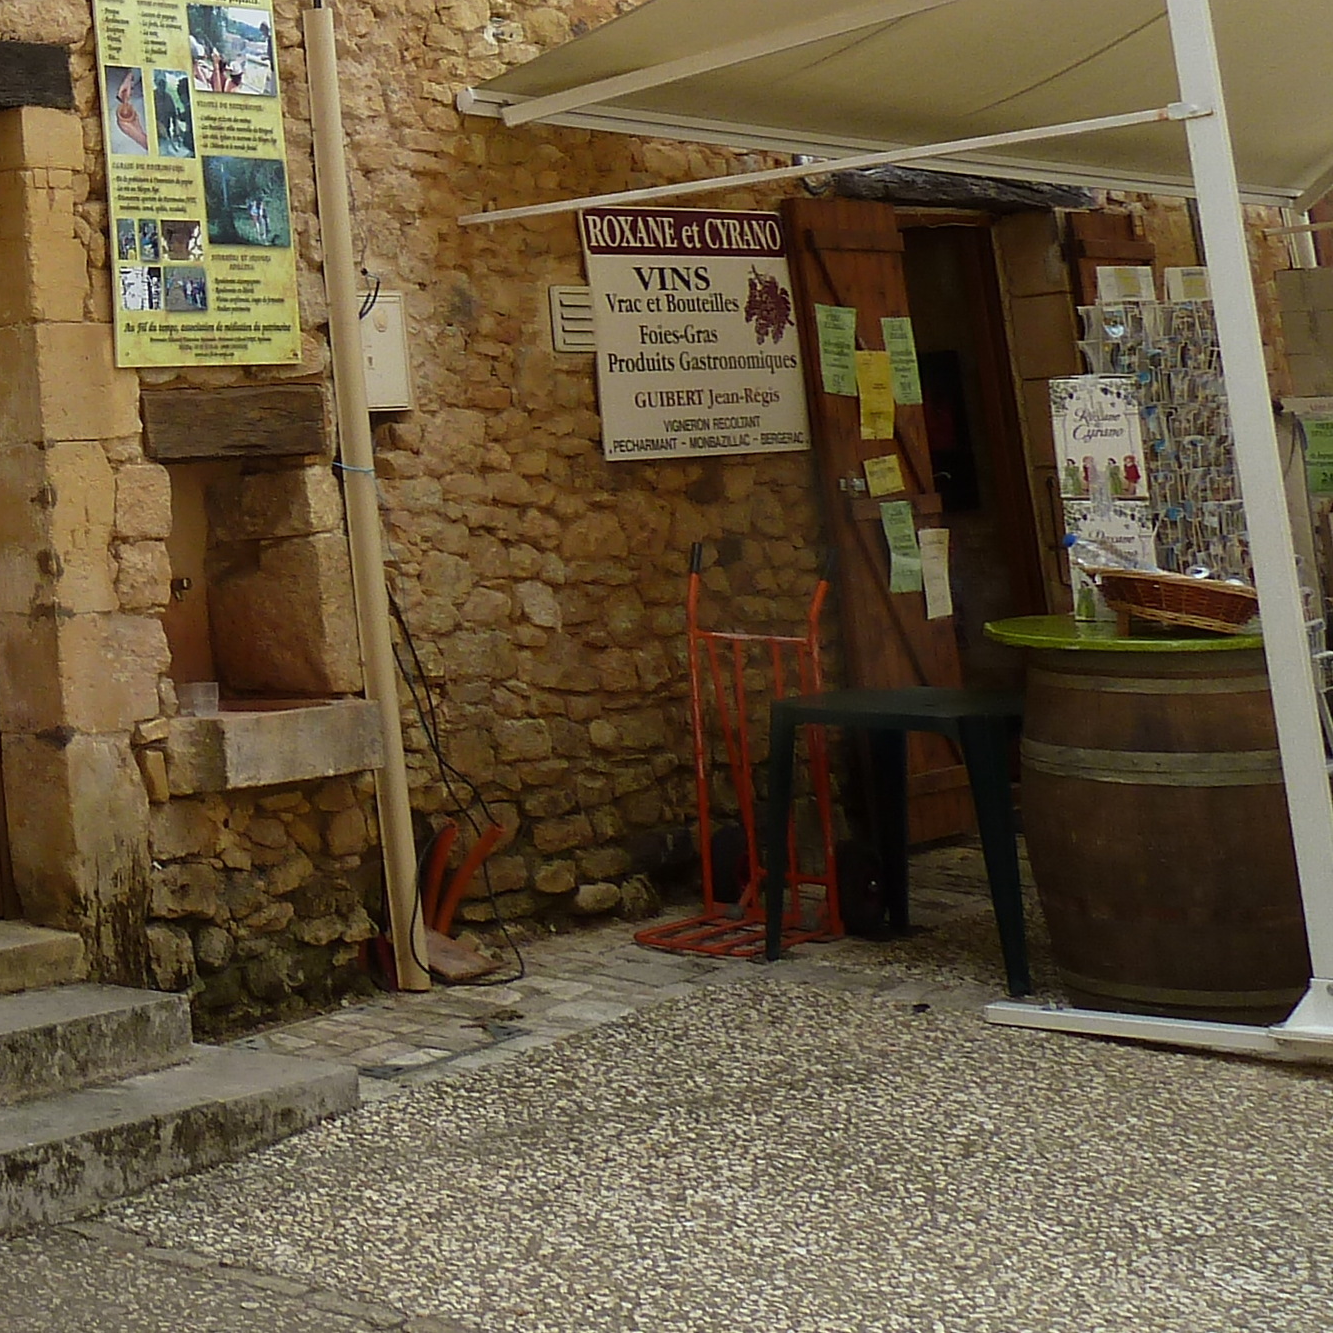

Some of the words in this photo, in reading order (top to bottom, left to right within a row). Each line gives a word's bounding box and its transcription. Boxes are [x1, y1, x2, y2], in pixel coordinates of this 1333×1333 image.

[586, 215, 678, 248] ROXANE
[682, 221, 700, 249] et
[704, 218, 781, 250] CYRANO
[633, 266, 710, 292] VINS
[606, 294, 642, 313] Vrac
[647, 295, 662, 313] et
[666, 293, 739, 313] Bouteilles
[639, 324, 718, 345] Foies-Gras
[608, 351, 675, 373] Produits
[679, 350, 797, 374] Gastronomiques
[635, 389, 703, 408] GUIBERT
[707, 386, 780, 409] Jean-Régis
[663, 418, 710, 433] VIGNERON
[613, 437, 677, 453] PECHARMANT
[689, 434, 750, 449] MONBAZILLAC
[760, 432, 804, 446] BERGERAC
